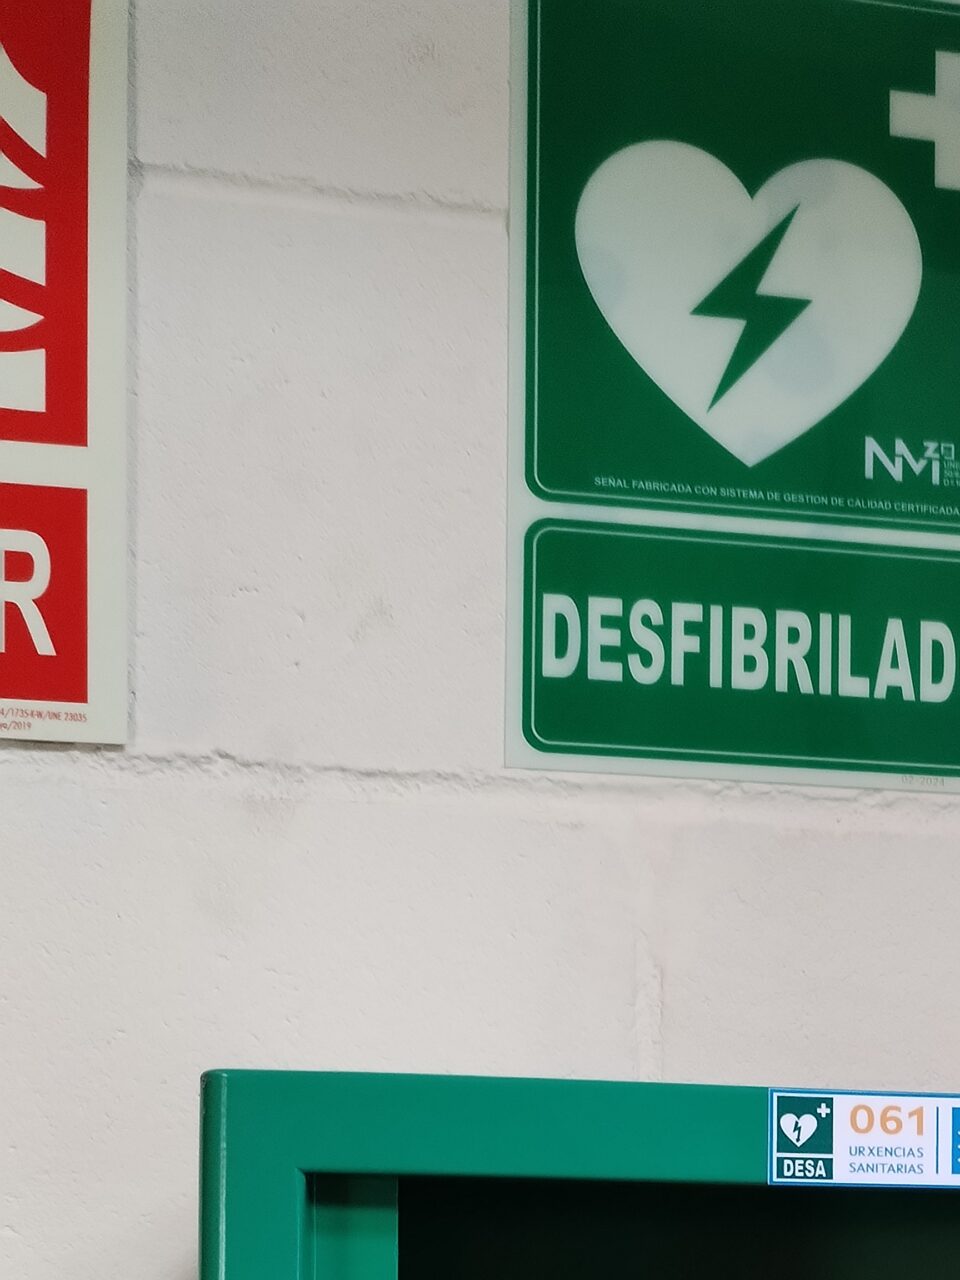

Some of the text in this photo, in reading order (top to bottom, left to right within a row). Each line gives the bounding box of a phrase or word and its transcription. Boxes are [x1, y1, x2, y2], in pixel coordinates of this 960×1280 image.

[631, 479, 692, 494] FABRICADA
[694, 485, 718, 497] CON
[720, 487, 764, 500] SISTEMA
[766, 491, 781, 501] DE
[783, 492, 829, 505] GESTION
[831, 496, 845, 507] DE
[847, 498, 892, 511] CALIDAD
[894, 501, 960, 517] CERTIFICADA
[850, 1104, 925, 1136] 061
[849, 1146, 924, 1158] URXENCIAS
[783, 1159, 827, 1178] DESA
[849, 1162, 924, 1175] SANITARIAS
